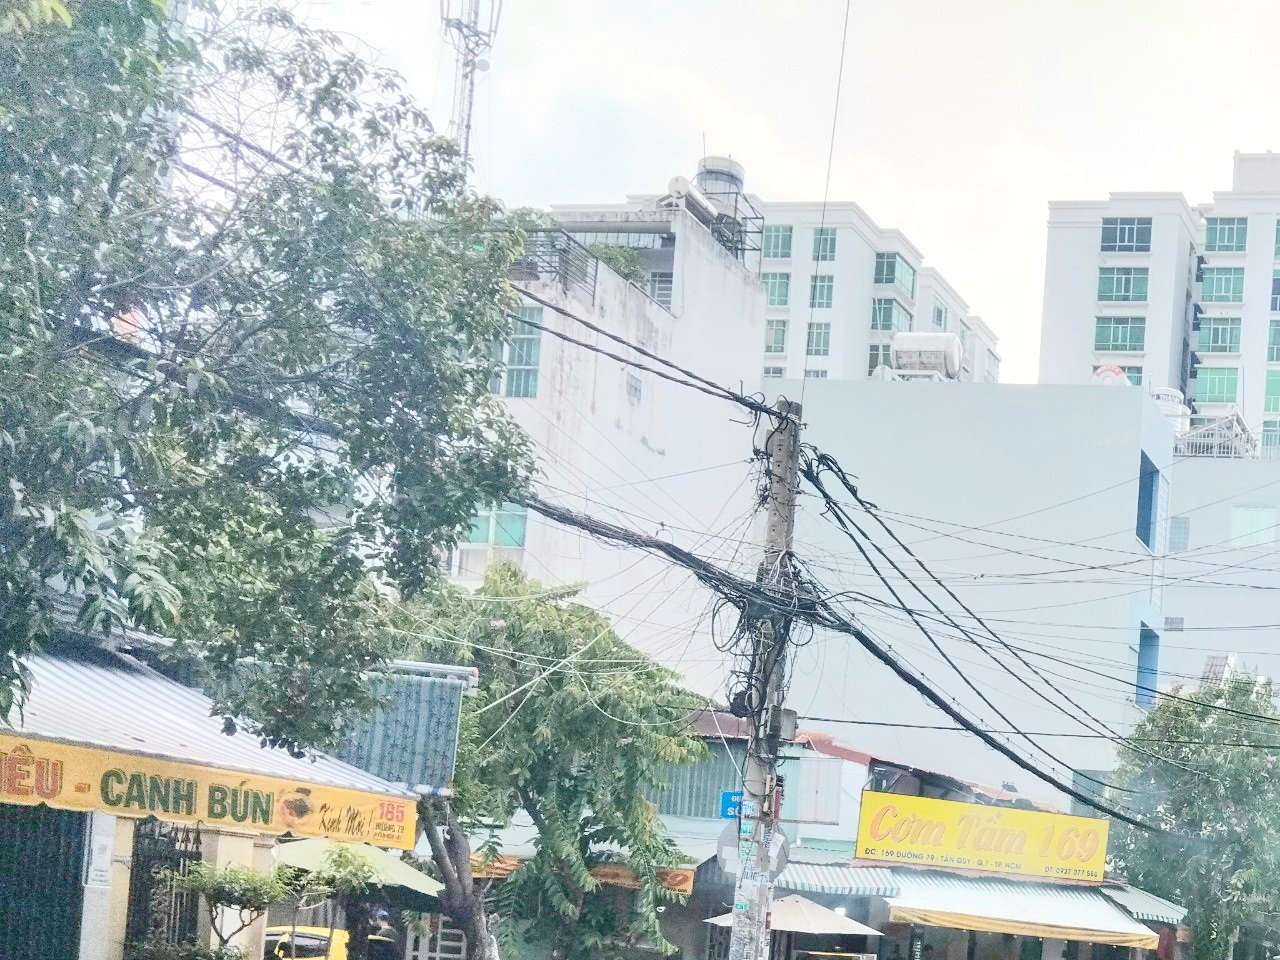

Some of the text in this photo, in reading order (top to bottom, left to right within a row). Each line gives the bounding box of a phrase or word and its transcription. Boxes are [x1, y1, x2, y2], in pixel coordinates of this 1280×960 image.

[100, 767, 198, 815] CANH
[208, 779, 275, 825] BÚN
[379, 801, 405, 822] 165
[869, 804, 1100, 864] Cơm Tấm 169
[926, 852, 935, 861] 79
[940, 853, 954, 863] TÂN
